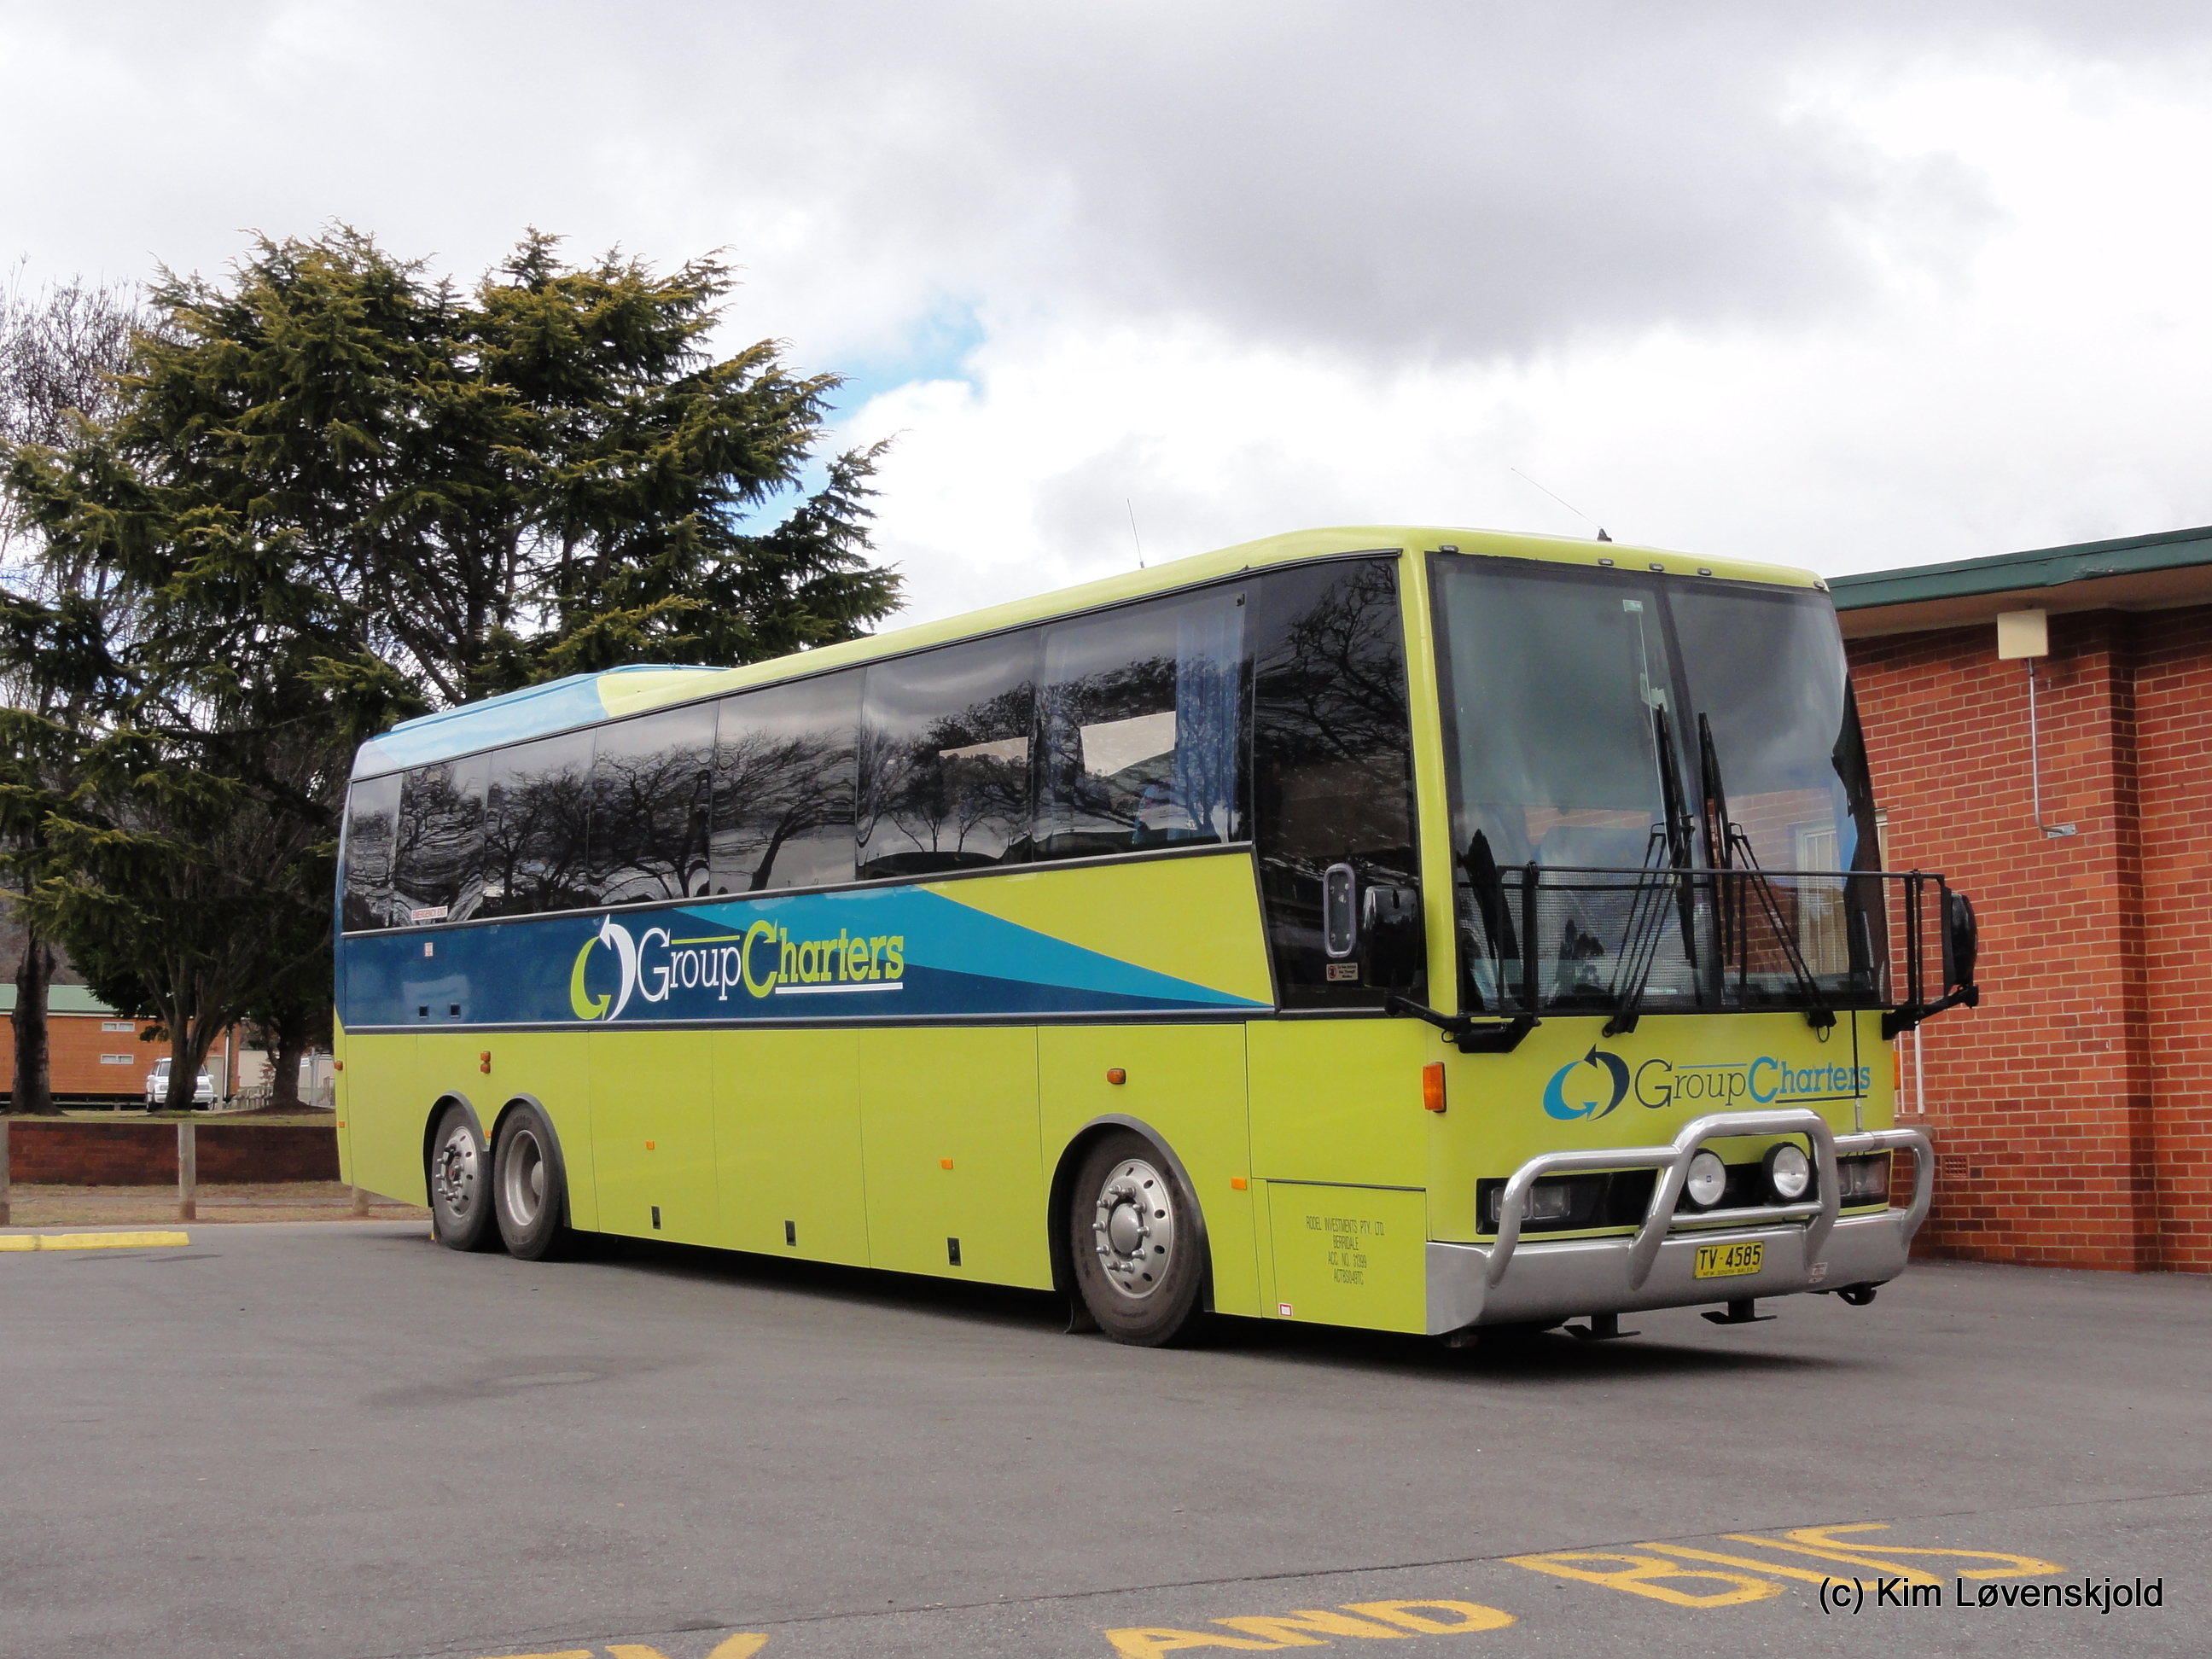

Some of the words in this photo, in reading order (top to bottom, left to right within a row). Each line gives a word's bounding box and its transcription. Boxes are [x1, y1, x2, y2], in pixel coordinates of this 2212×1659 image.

[1324, 1217, 1358, 1234] INVESTMENTS
[1333, 1235, 1359, 1250] BERRIDALE
[1106, 1598, 1518, 1659] AND
[1504, 1523, 2068, 1610] BUS
